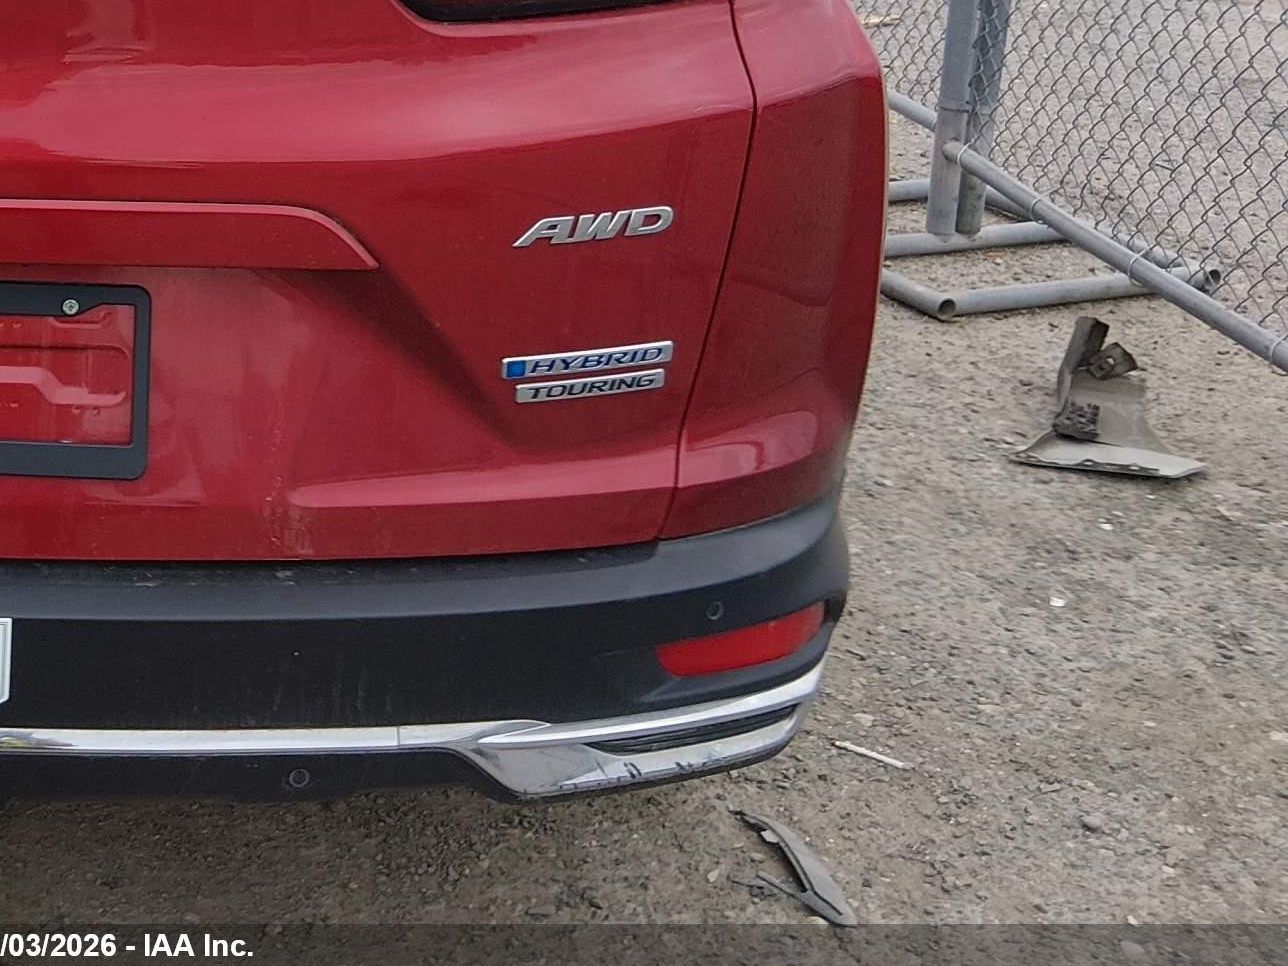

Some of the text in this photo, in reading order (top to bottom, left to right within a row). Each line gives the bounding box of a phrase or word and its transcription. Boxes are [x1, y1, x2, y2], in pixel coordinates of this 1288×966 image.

[512, 205, 674, 248] AWD
[529, 347, 663, 374] HYBRID
[527, 374, 657, 400] TOURING
